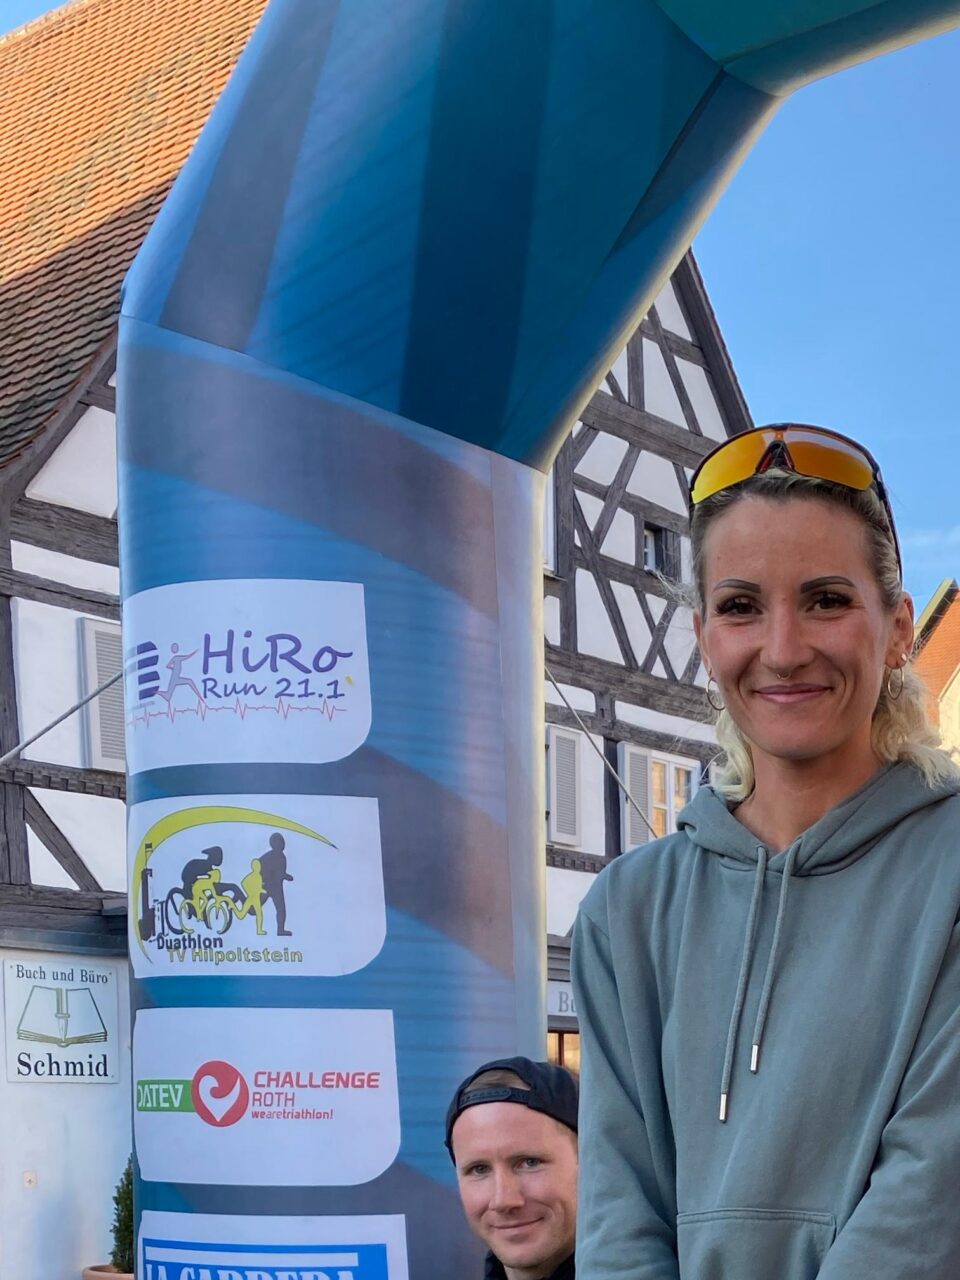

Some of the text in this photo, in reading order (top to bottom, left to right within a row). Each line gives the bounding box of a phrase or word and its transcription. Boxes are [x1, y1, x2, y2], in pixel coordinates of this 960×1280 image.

[202, 629, 353, 675] HiRo
[202, 678, 345, 699] Run 21.1
[156, 933, 223, 949] Duathlon
[167, 947, 303, 966] TV Hilpoltstein
[16, 964, 108, 984] Buch und Büro
[17, 1052, 109, 1077] Schmid
[254, 1071, 380, 1089] CHALLENGE
[252, 1092, 295, 1107] ROTH
